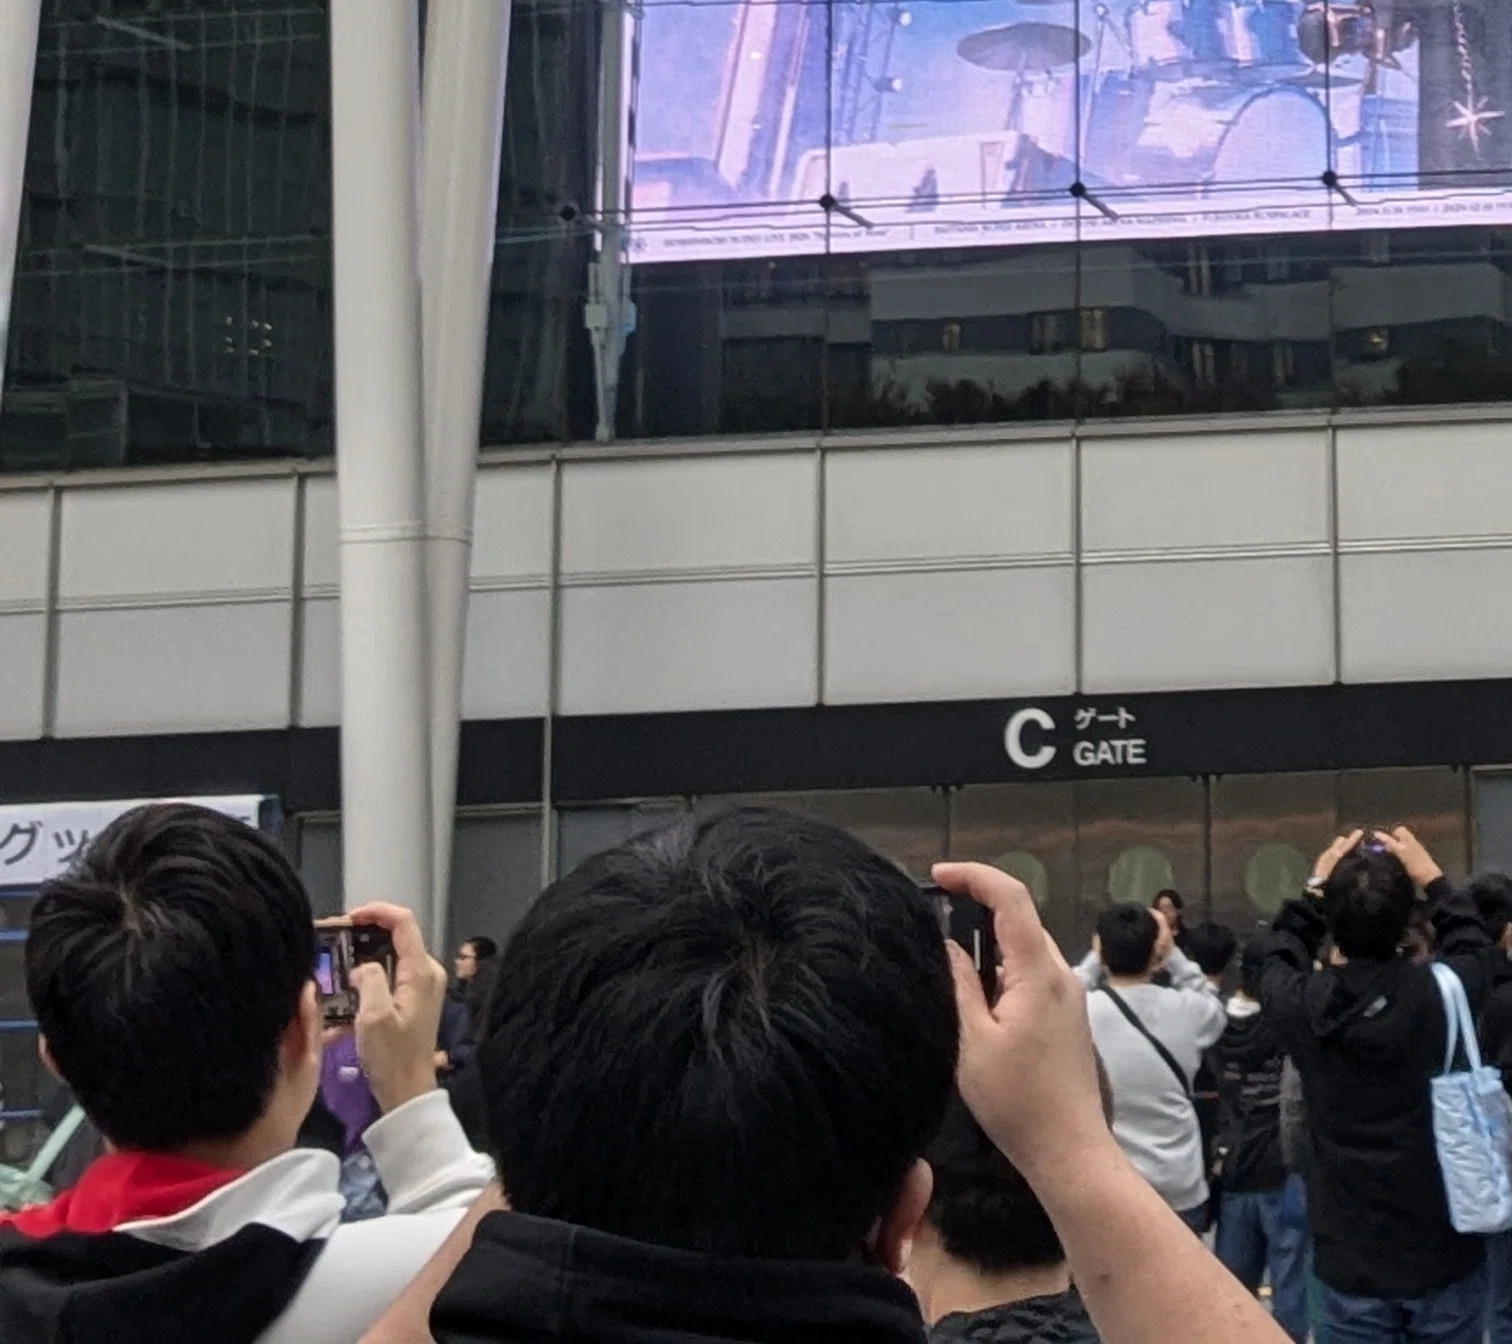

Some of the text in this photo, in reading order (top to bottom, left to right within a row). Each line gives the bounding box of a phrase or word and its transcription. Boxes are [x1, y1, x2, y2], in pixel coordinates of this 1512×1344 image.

[1073, 707, 1136, 730] ゲート
[1004, 708, 1056, 769] C
[1073, 738, 1147, 766] GATE
